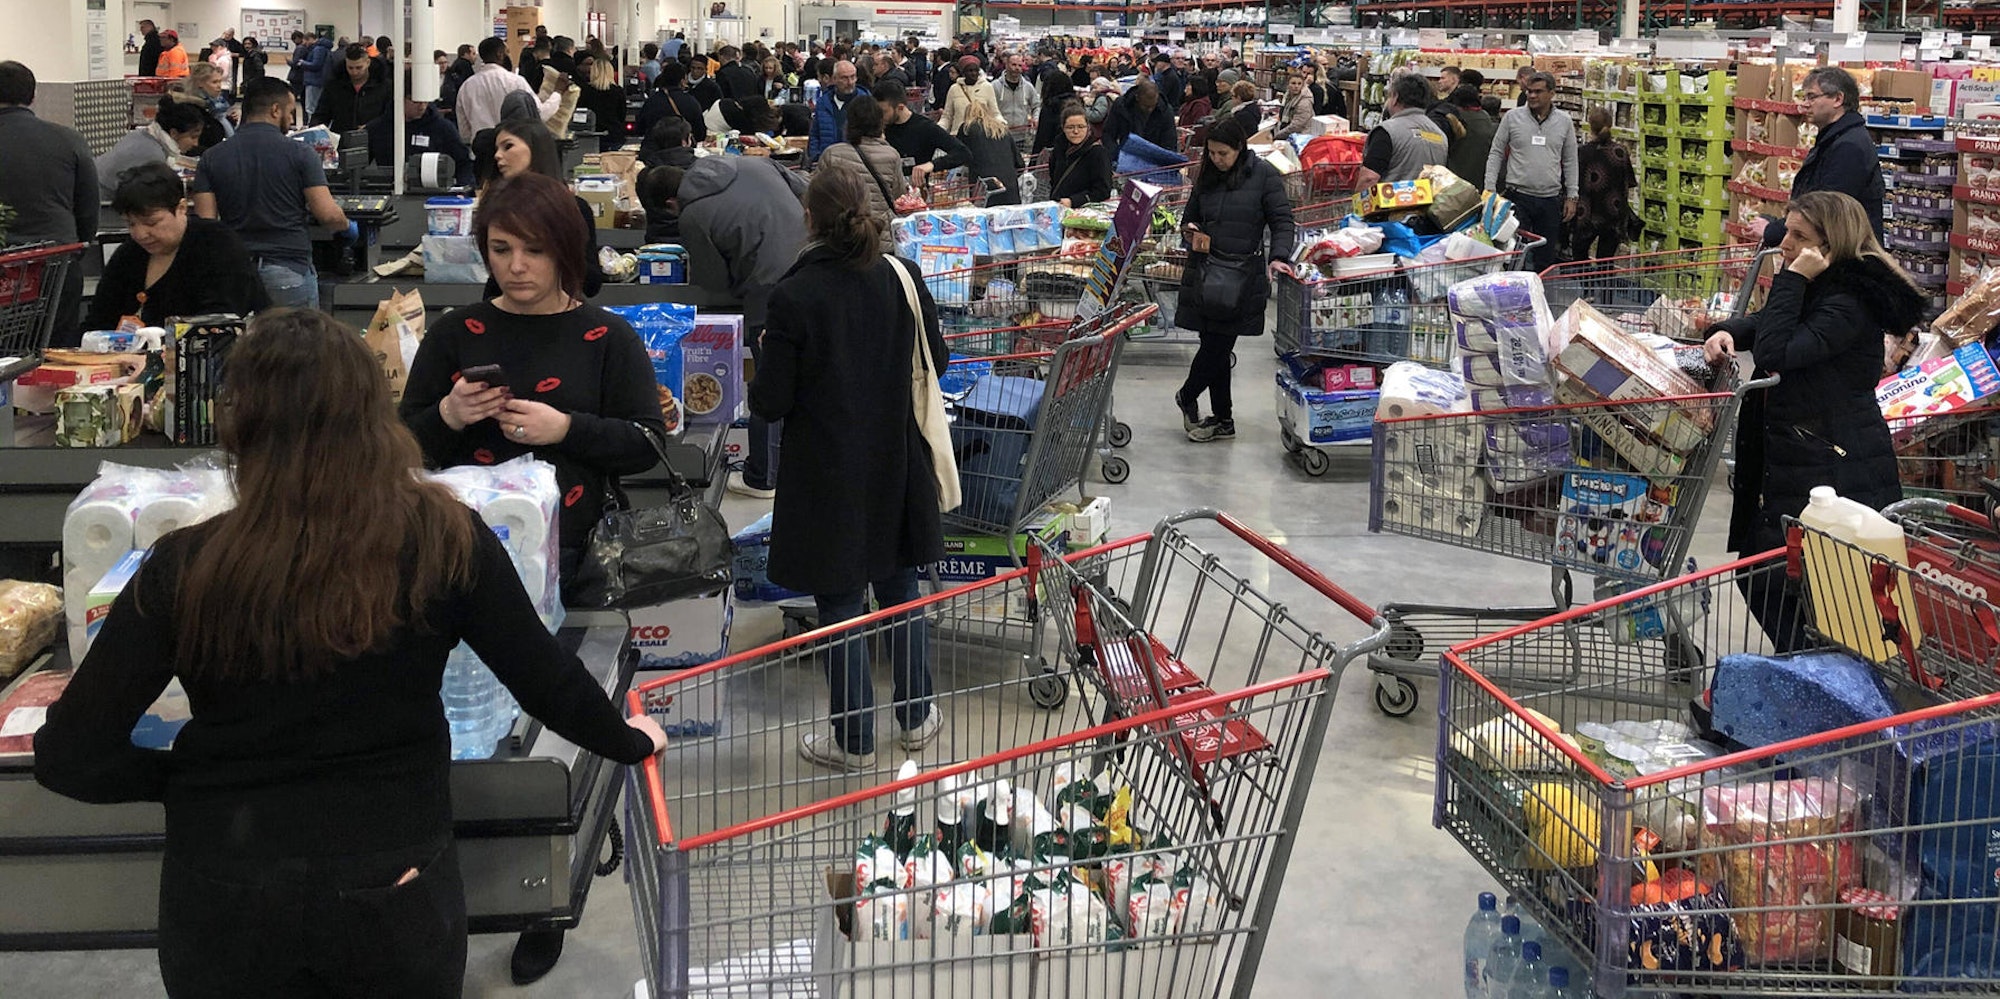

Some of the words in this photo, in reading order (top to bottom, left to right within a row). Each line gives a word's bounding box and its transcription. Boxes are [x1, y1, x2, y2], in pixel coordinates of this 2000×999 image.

[1876, 375, 1928, 403] anonino
[943, 541, 964, 549] LAND
[630, 625, 671, 640] TCO
